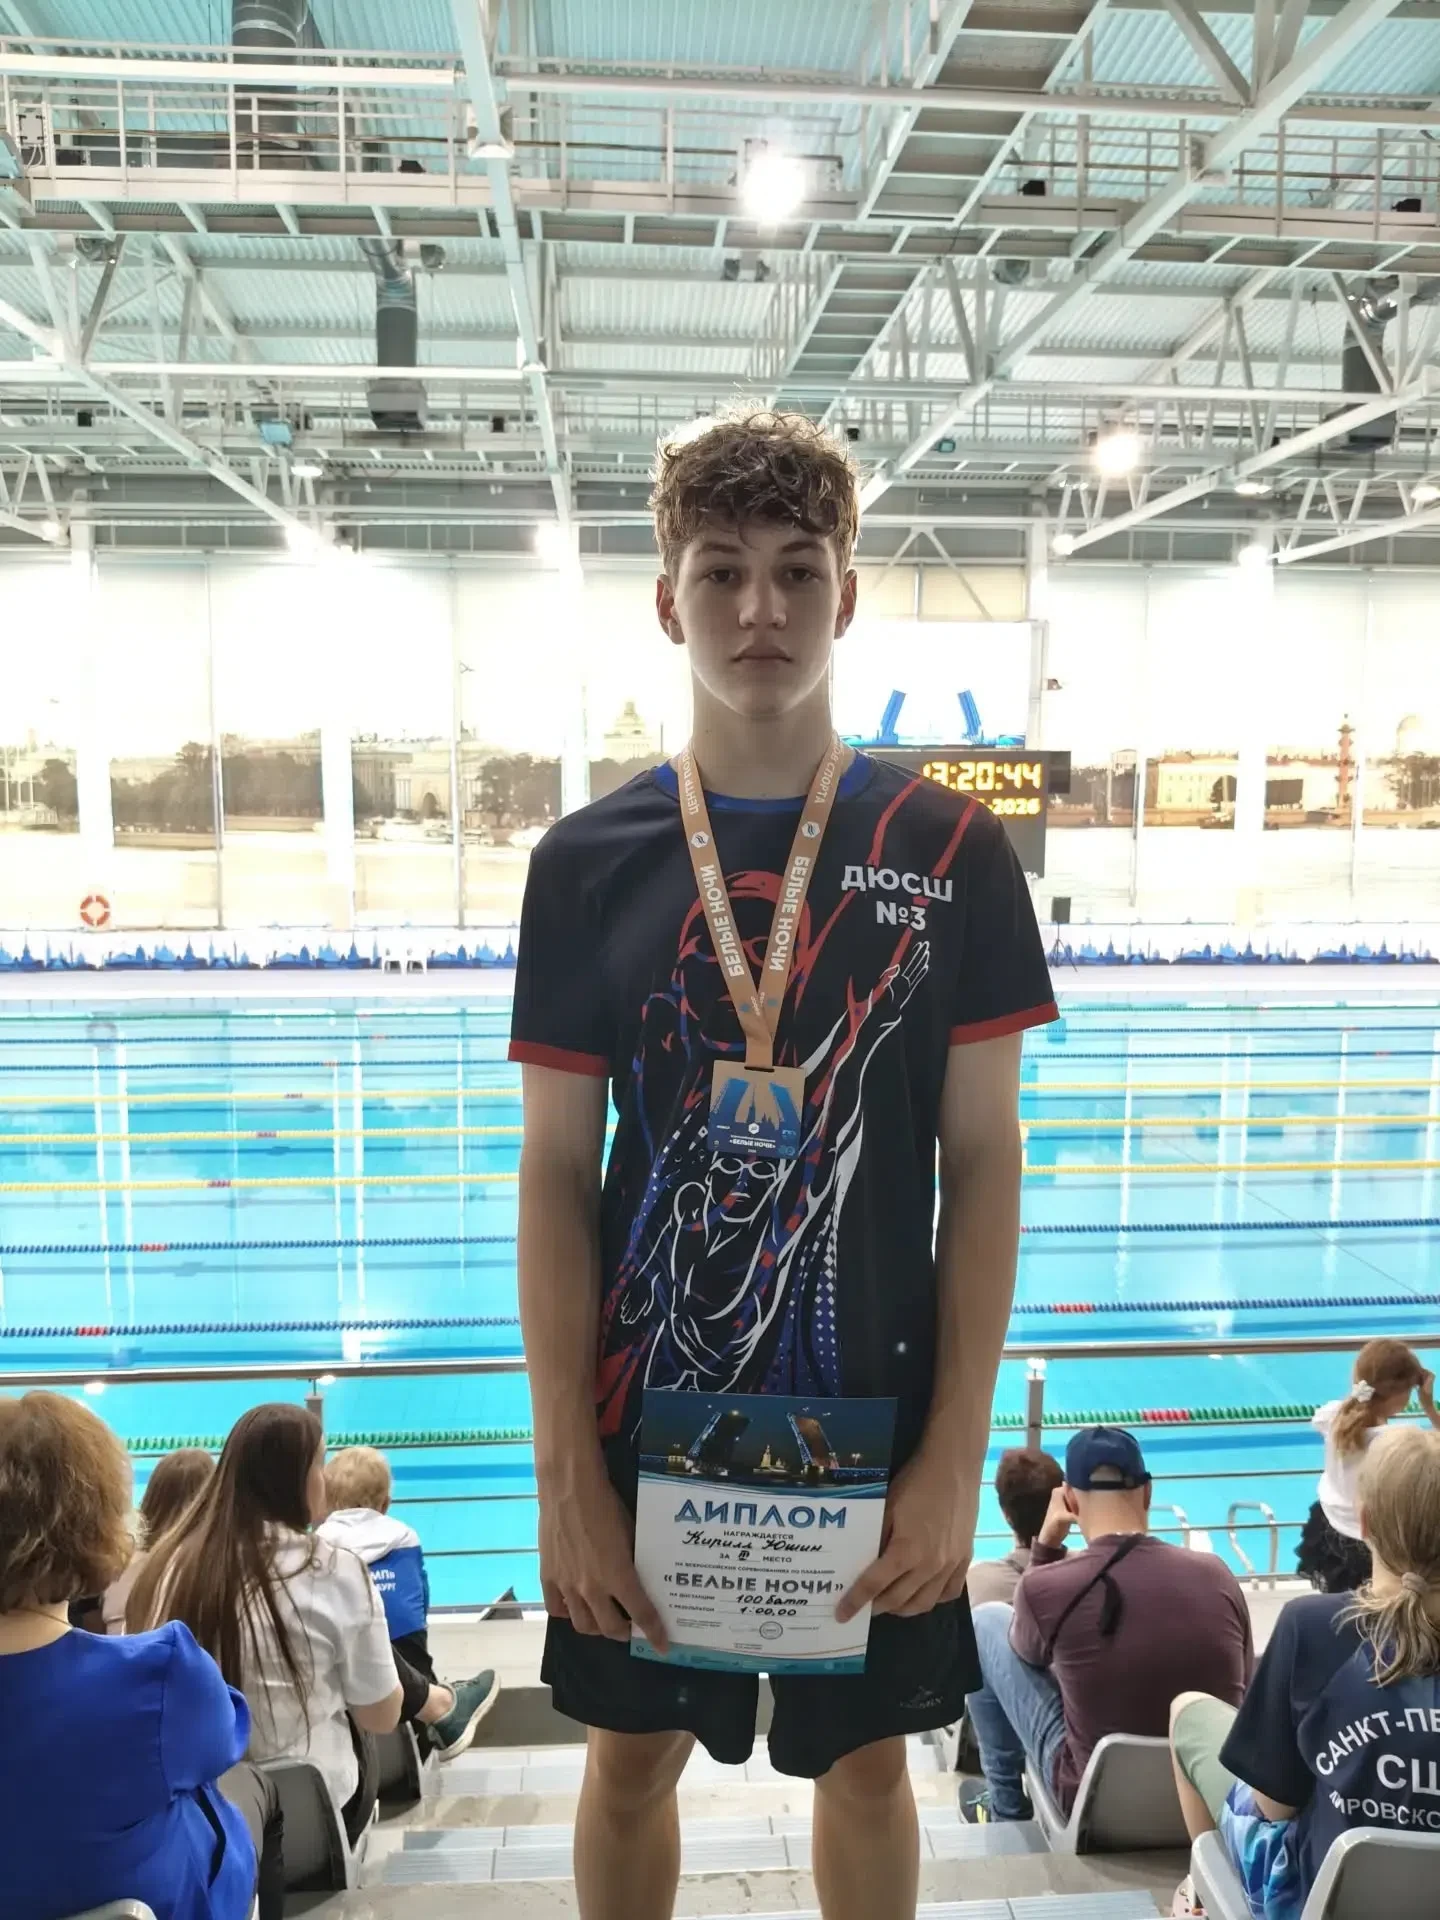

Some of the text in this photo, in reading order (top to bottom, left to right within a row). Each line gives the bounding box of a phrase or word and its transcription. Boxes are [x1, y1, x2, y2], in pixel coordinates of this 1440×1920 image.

[684, 779, 699, 815] ЦЕНТР
[814, 762, 836, 803] СПОРТА
[841, 865, 953, 902] ДЮСШ
[699, 864, 745, 977] БЕЛЫЕ НОЧИ
[769, 855, 811, 971] БЕЛЫЕ НОЧИ
[876, 900, 926, 930] №3
[674, 1499, 847, 1529] ДИПЛОМ
[682, 1530, 753, 1548] Кирилл
[723, 1530, 794, 1541] НАГРАЖДАЕТСЯ
[719, 1552, 730, 1560] ЗА
[664, 1572, 844, 1595] «БЕЛЫЕ НОЧИ»
[736, 1594, 764, 1604] 100
